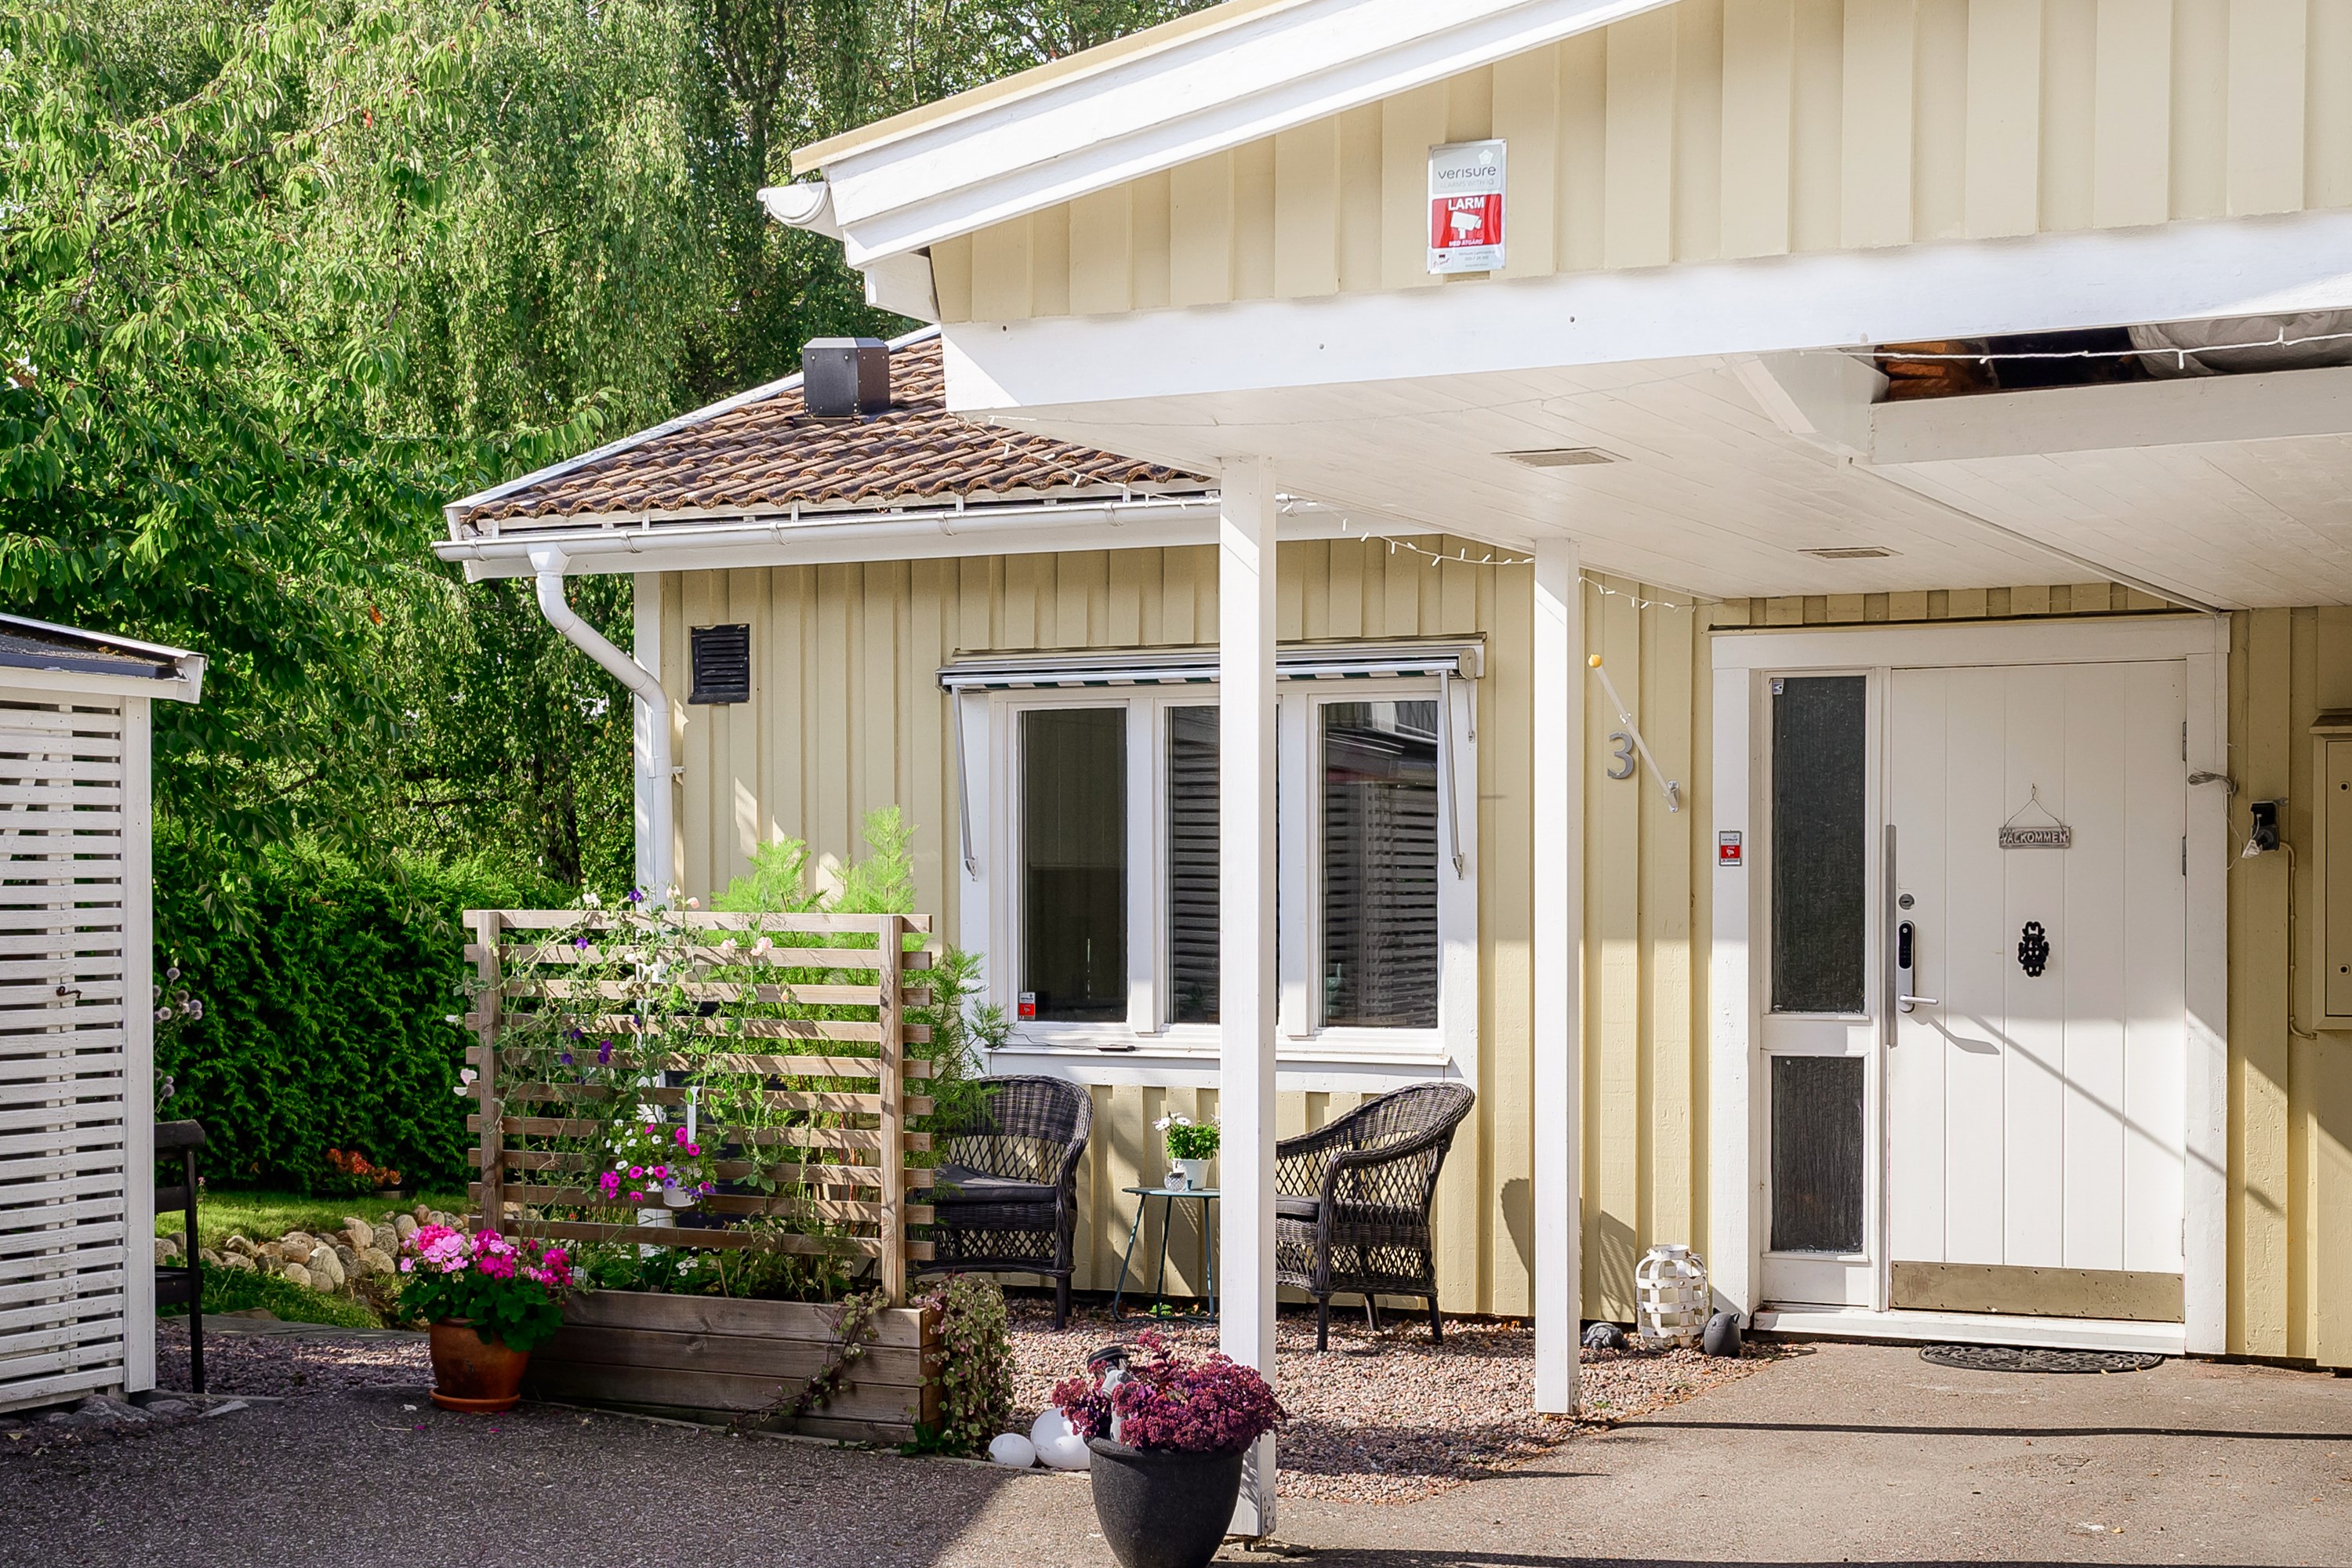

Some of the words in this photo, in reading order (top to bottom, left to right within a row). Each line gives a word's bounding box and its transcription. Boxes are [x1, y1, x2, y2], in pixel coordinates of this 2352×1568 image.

[1438, 165, 1497, 180] verisure
[1447, 196, 1485, 211] LARM
[1607, 731, 1634, 779] 3
